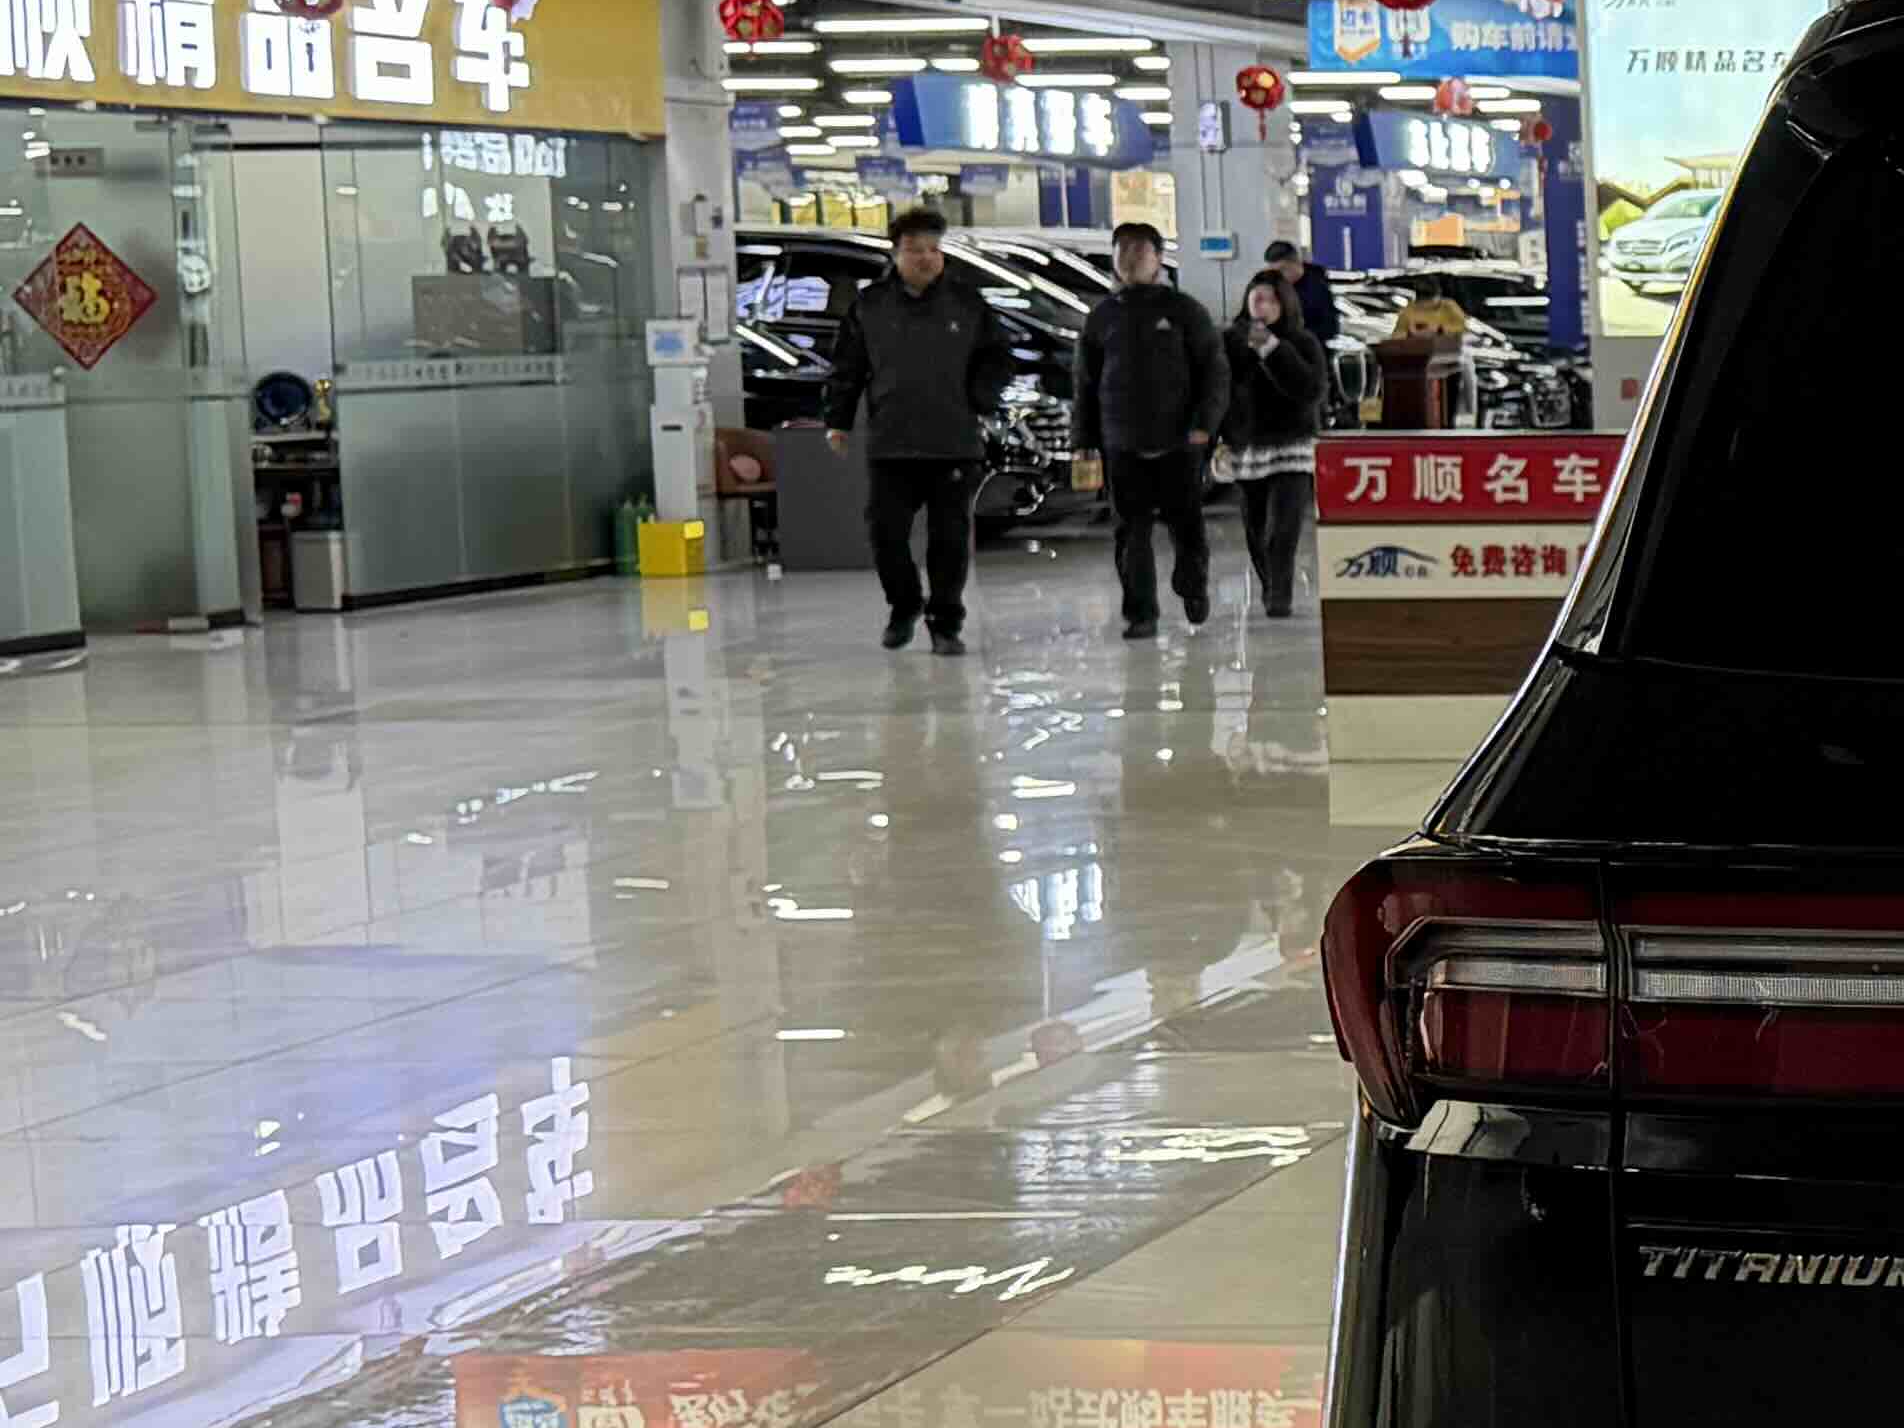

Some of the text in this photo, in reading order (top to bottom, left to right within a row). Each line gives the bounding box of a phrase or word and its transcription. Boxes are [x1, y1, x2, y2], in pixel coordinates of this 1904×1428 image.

[1343, 454, 1602, 503] 万顺名车
[1450, 544, 1568, 579] 免费咨询
